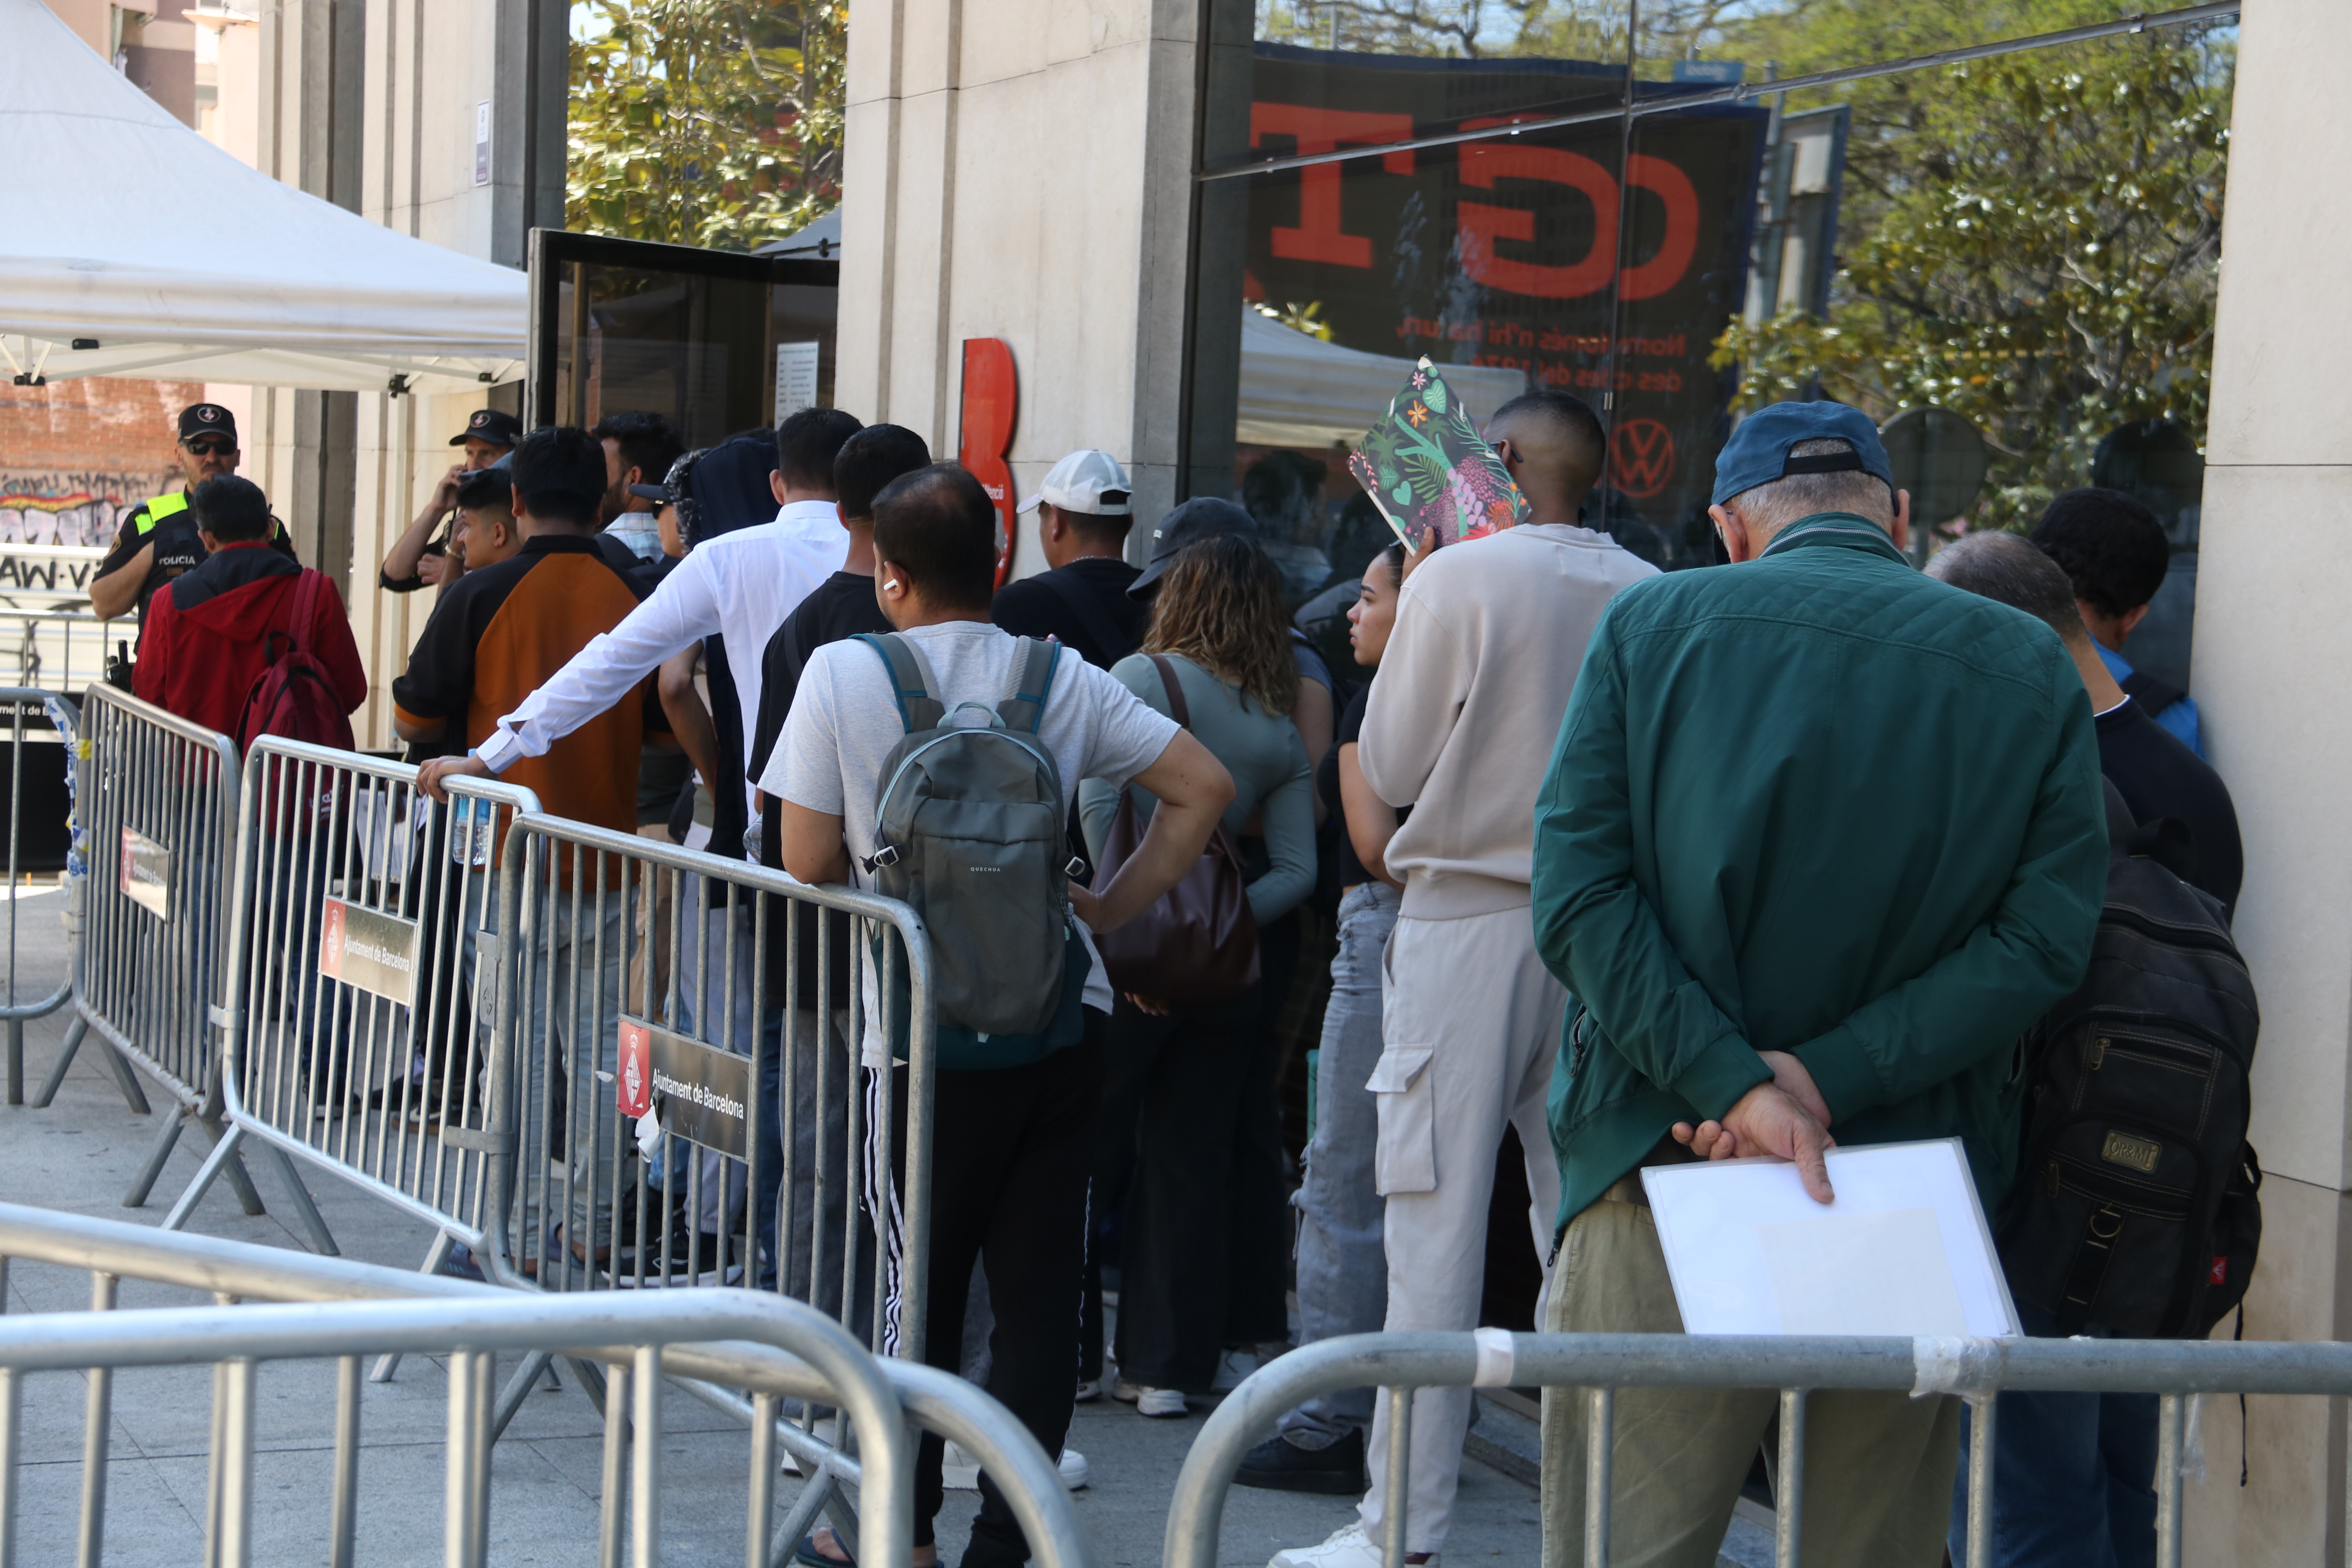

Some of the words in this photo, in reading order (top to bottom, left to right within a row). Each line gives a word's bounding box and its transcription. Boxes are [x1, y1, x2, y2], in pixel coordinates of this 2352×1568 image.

[344, 935, 373, 959] Ajuntament
[374, 945, 381, 962] de
[382, 947, 409, 972] Barcelona
[693, 1083, 703, 1104] de
[704, 1086, 744, 1120] Barcelona
